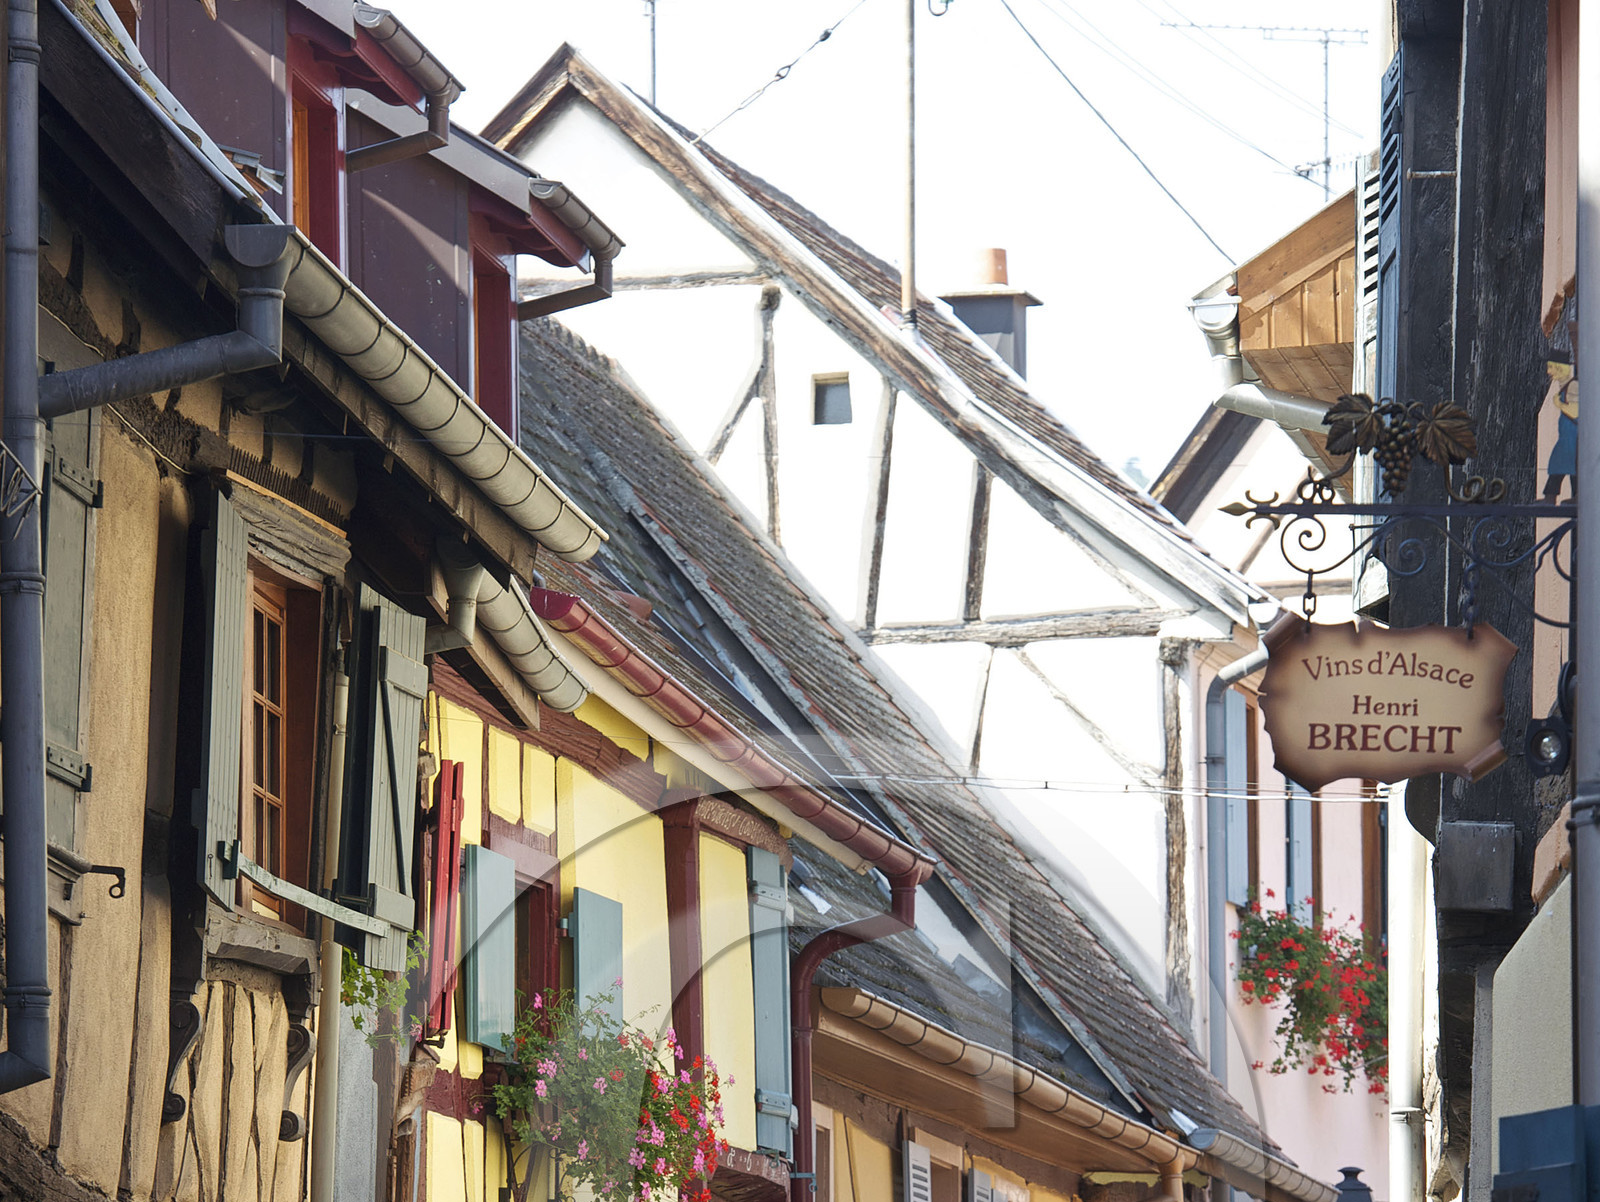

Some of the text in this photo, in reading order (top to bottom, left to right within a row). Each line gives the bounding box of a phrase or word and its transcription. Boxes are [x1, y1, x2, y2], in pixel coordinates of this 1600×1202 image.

[1302, 650, 1475, 690] Vins d'Alsace
[1352, 694, 1419, 717] Henri
[1307, 722, 1463, 755] BRECHT
